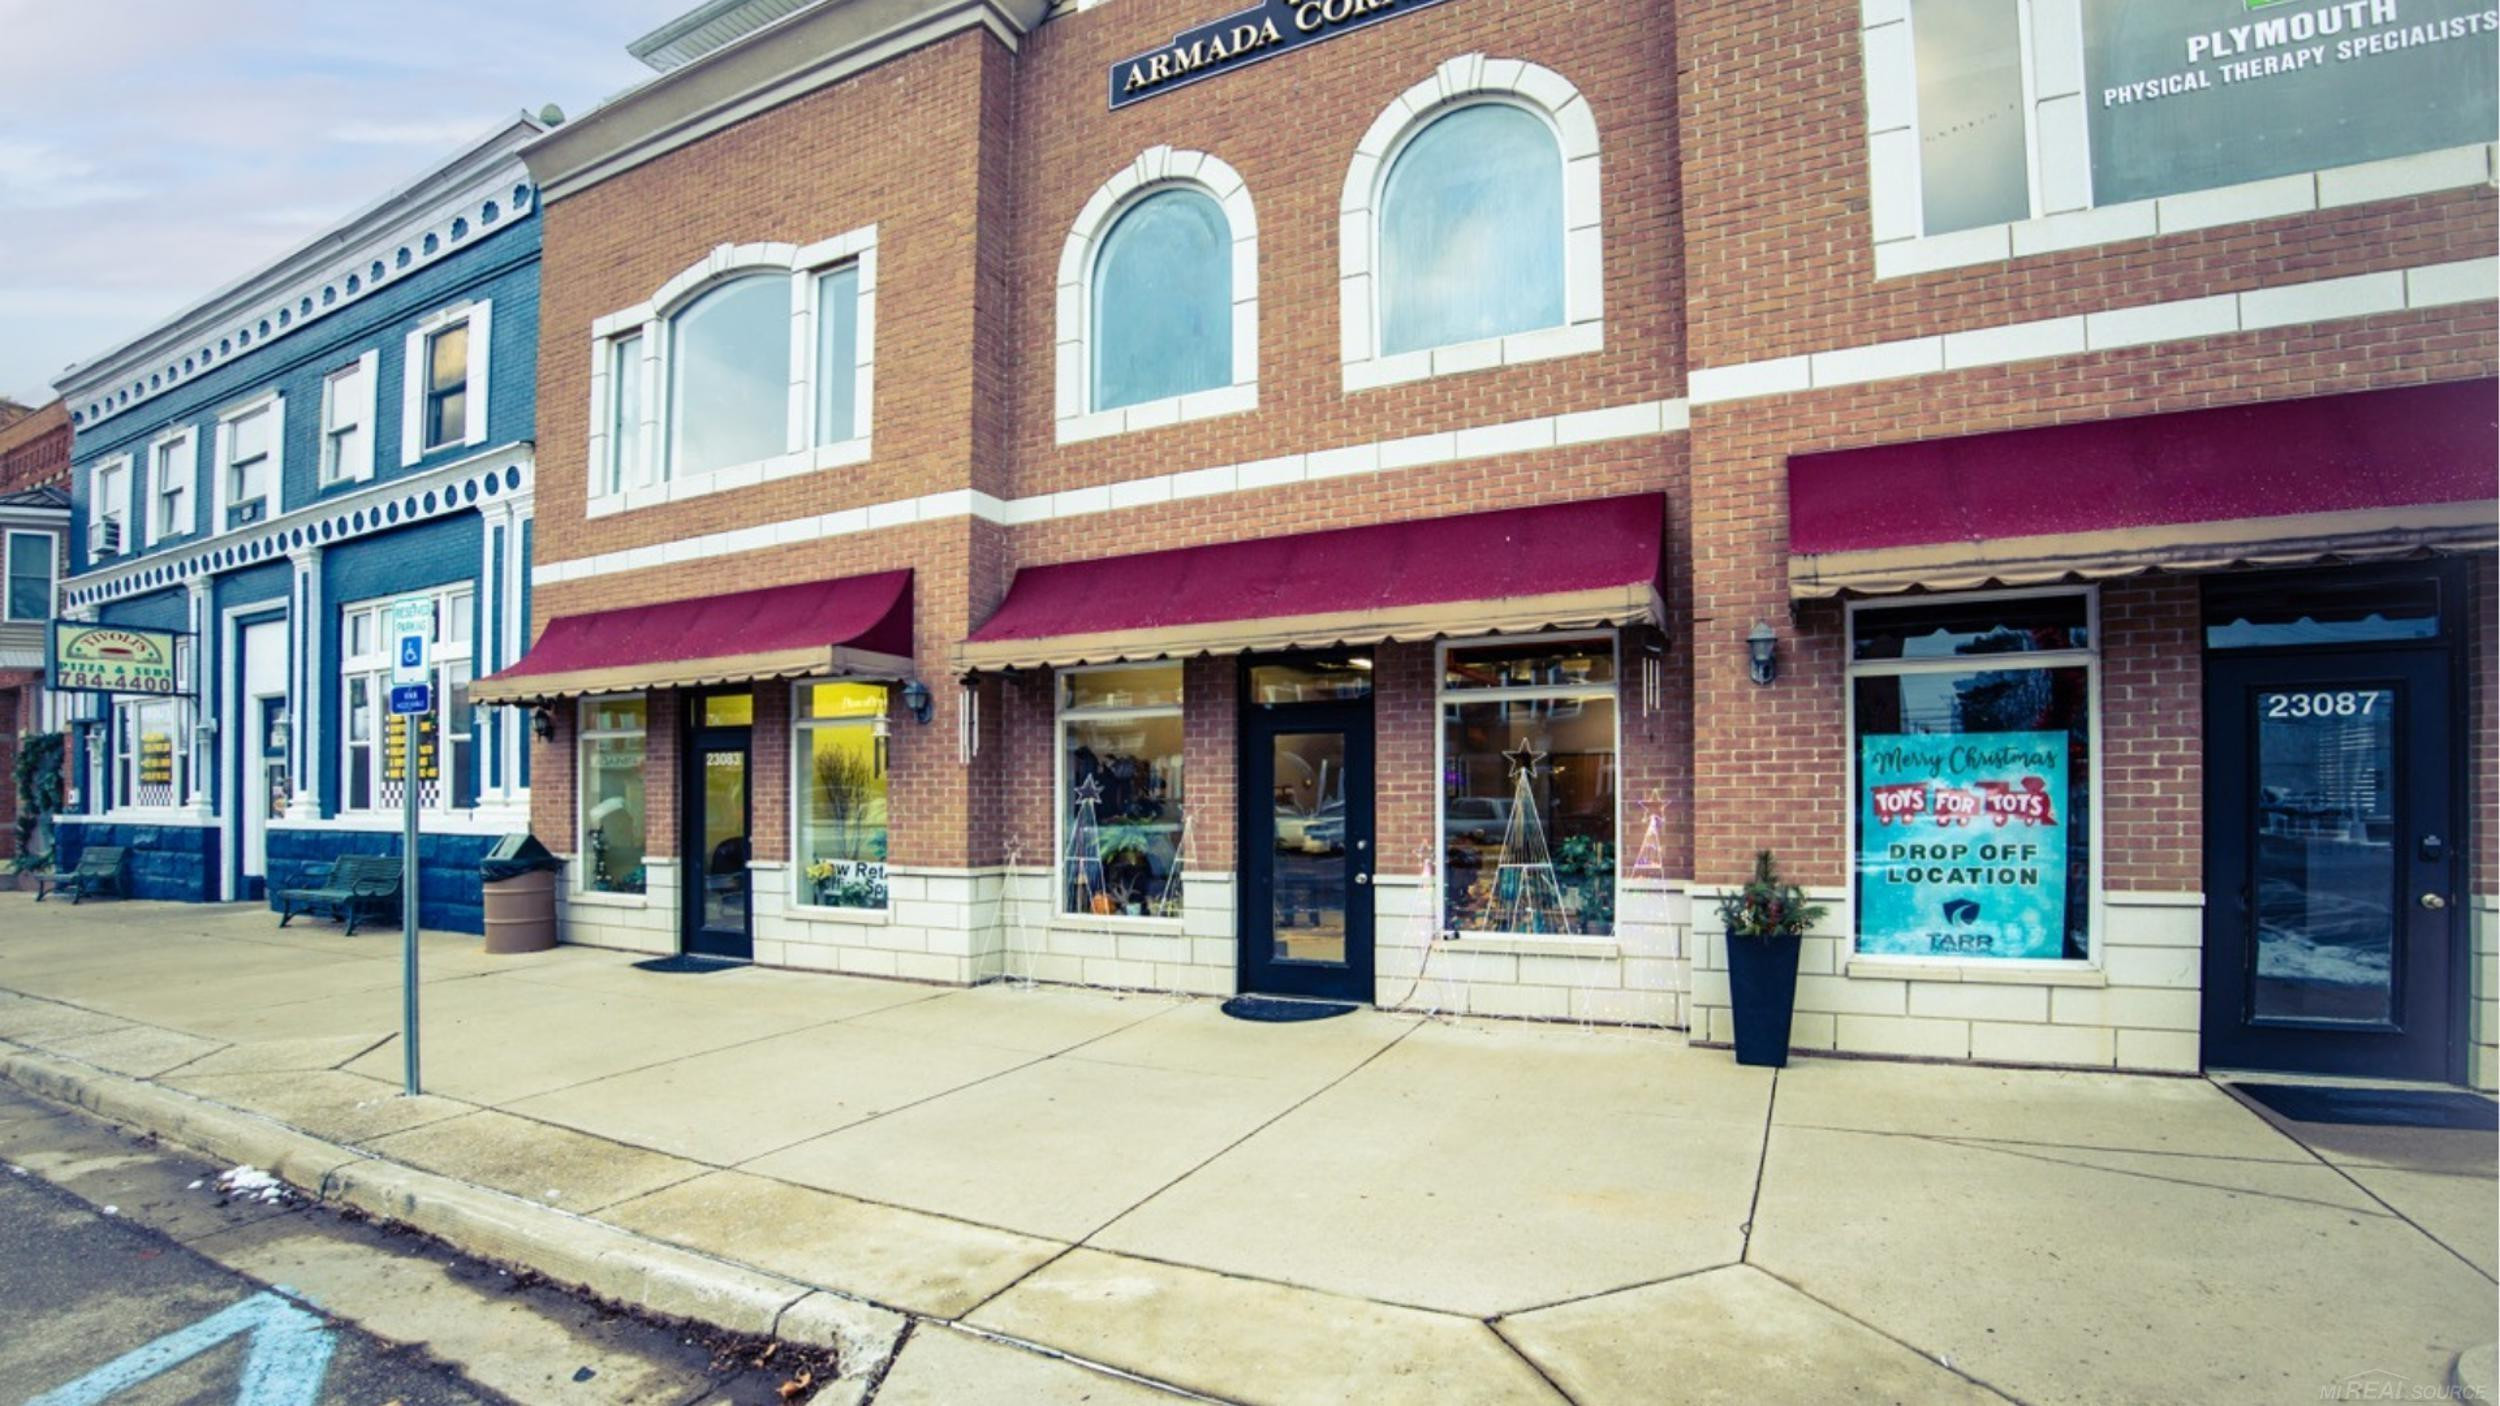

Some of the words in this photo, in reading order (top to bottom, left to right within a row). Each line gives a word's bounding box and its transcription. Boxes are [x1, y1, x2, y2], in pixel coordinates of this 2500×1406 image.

[2187, 0, 2397, 63] PLYMOUTH
[1124, 17, 1281, 91] ARMADA
[2104, 70, 2211, 107] PHYSICAL
[2219, 46, 2326, 84] THERAPY
[2336, 10, 2499, 61] SPECIALISTS
[60, 661, 106, 673] PIZZA
[134, 666, 171, 678] SUBS
[60, 671, 170, 691] 784-4400
[2268, 692, 2379, 717] 23087
[1871, 748, 1943, 778] Merry
[1950, 746, 2057, 775] Christmas
[1876, 788, 1925, 812] TOYS
[1935, 794, 1975, 814] FOR
[1988, 793, 2043, 815] TOTS
[1890, 844, 1968, 860] DROP
[1979, 844, 2037, 861] OFF
[1888, 867, 2038, 884] LOCATION
[1926, 933, 1993, 949] TARR
